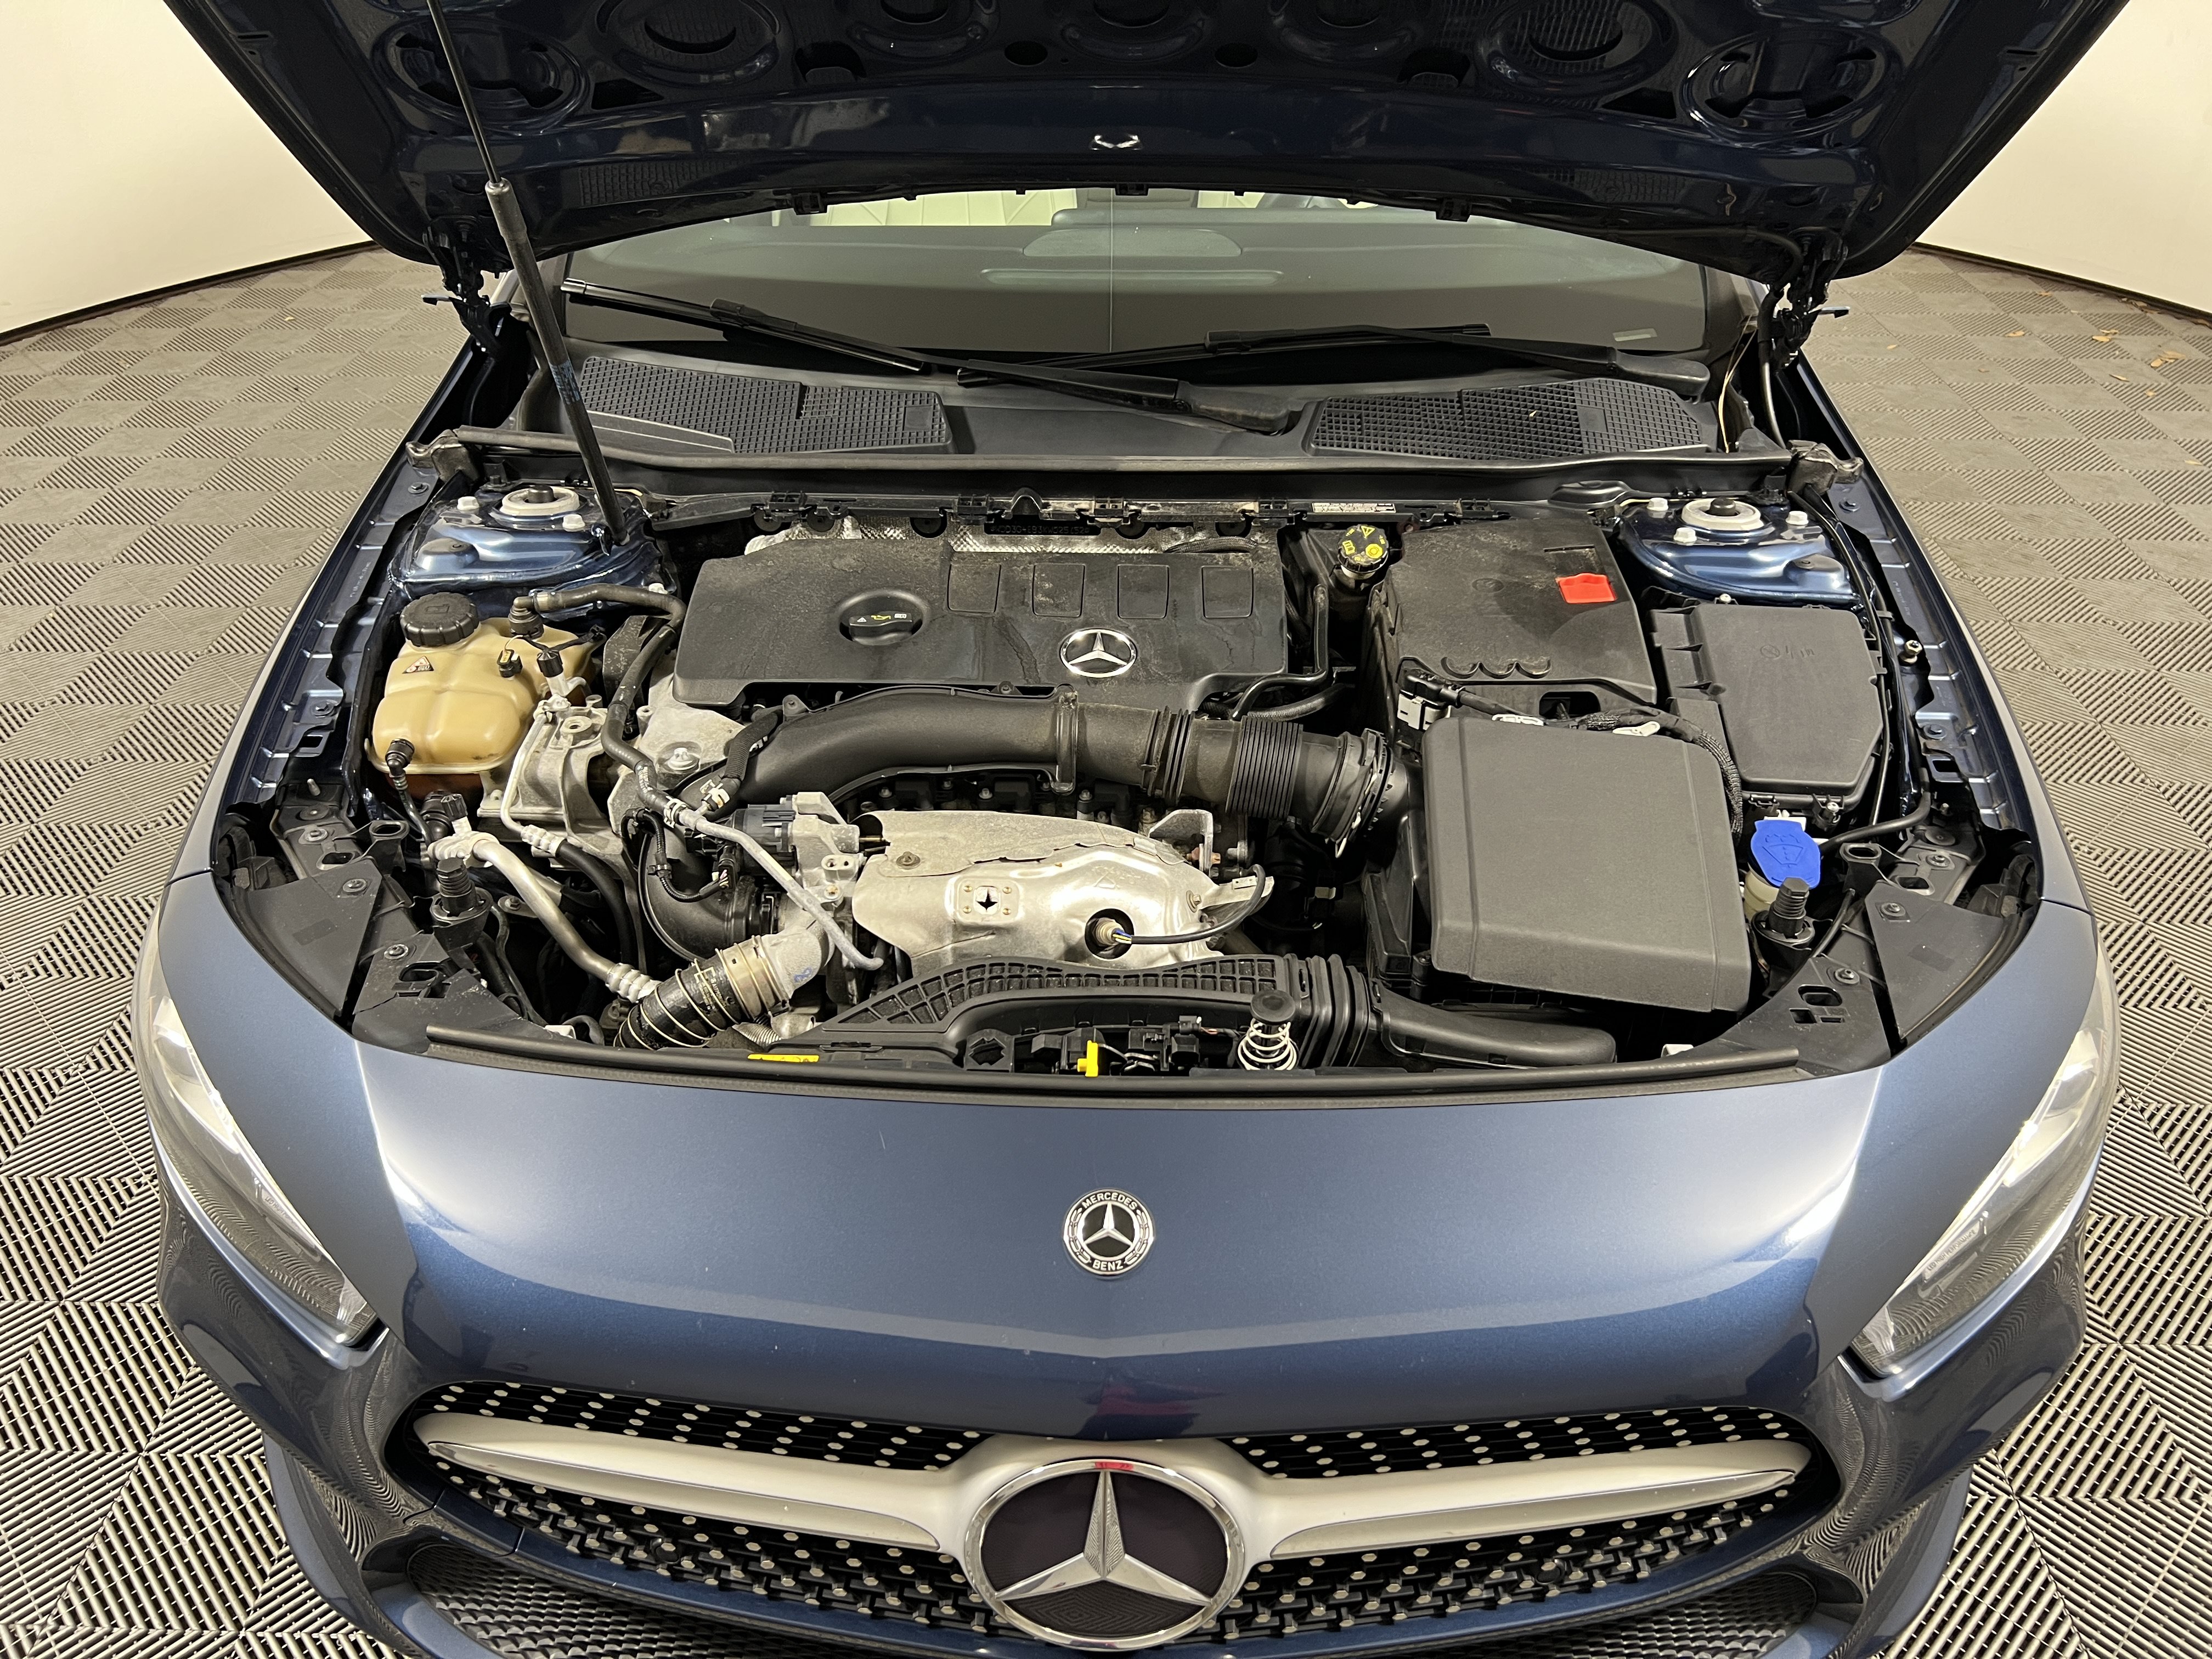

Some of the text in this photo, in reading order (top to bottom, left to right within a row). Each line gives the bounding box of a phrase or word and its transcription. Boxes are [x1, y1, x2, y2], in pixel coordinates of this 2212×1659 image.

[1082, 1192, 1138, 1210] MERCEDES
[1092, 1260, 1124, 1271] BENZ
[1926, 1261, 1937, 1271] LED
